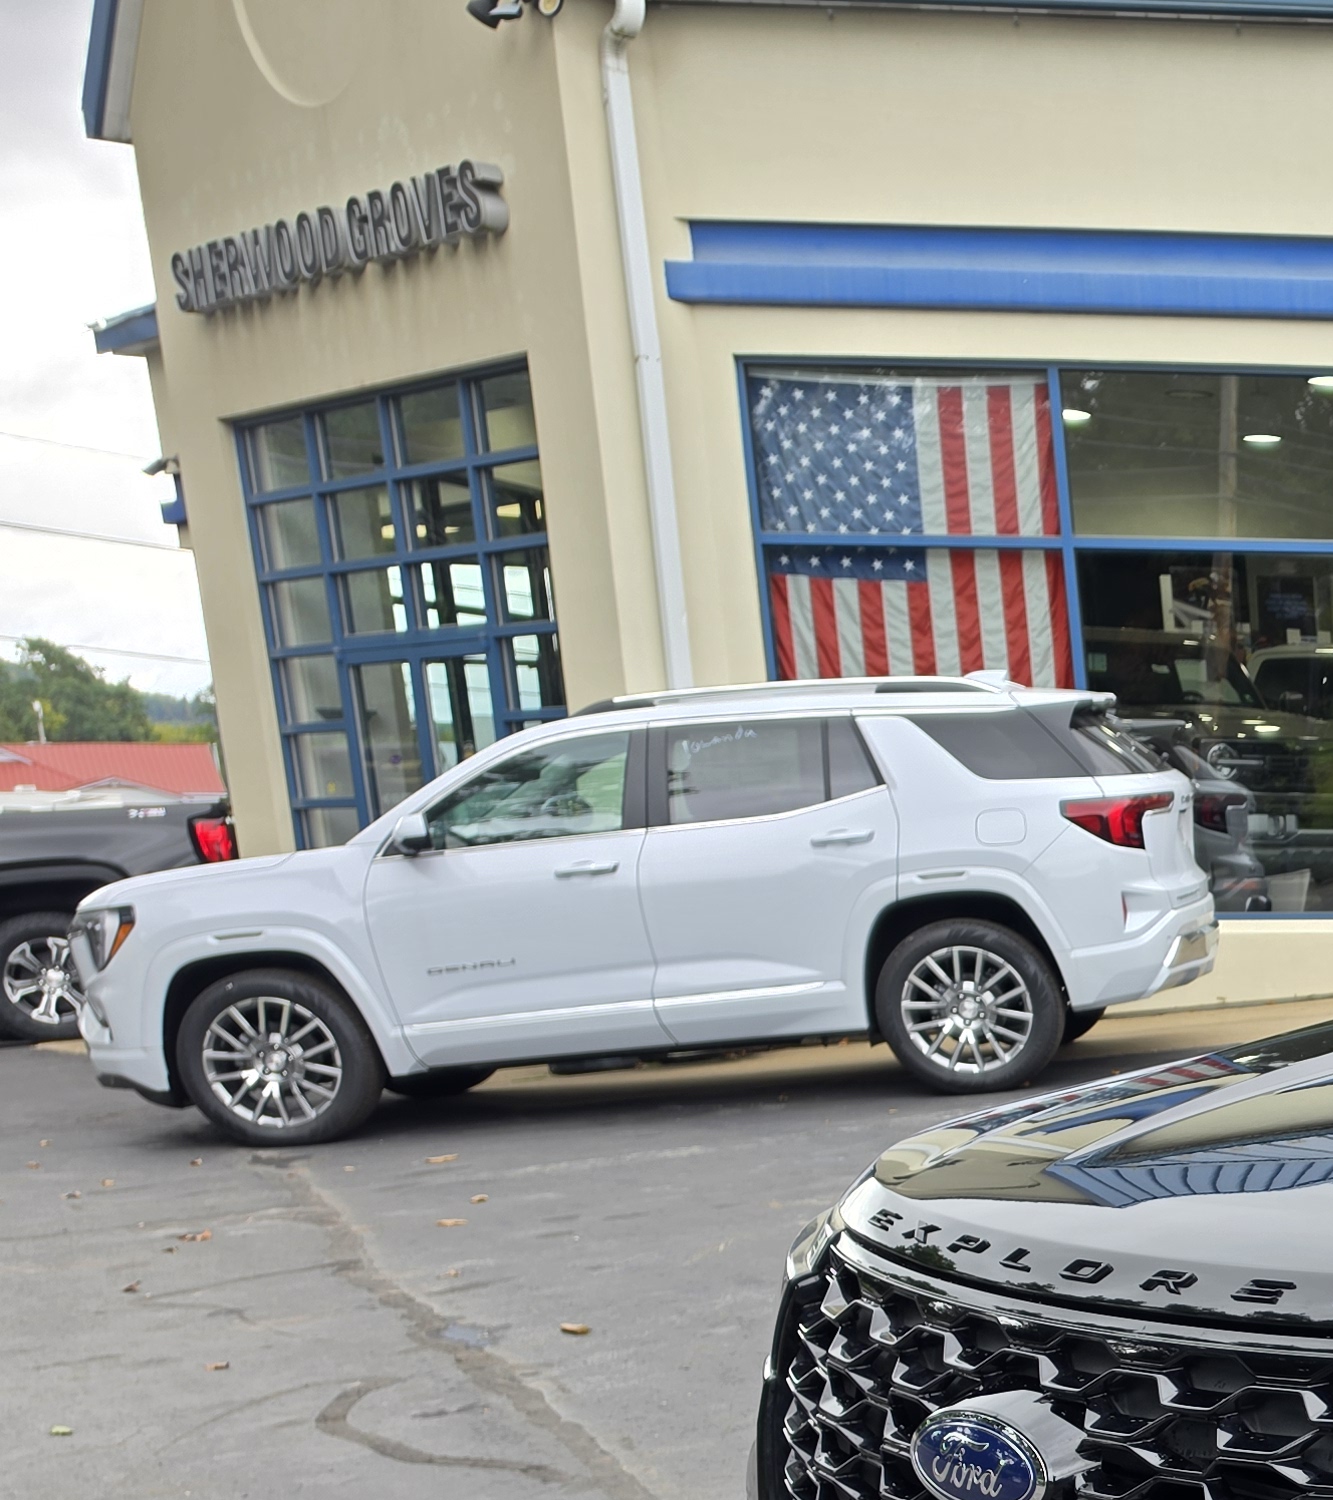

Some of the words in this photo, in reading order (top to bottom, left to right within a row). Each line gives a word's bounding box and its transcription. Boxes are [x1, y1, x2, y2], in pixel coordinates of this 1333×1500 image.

[171, 206, 340, 312] SHERWOOD
[346, 159, 509, 266] GROVES
[931, 1433, 1005, 1498] Ford
